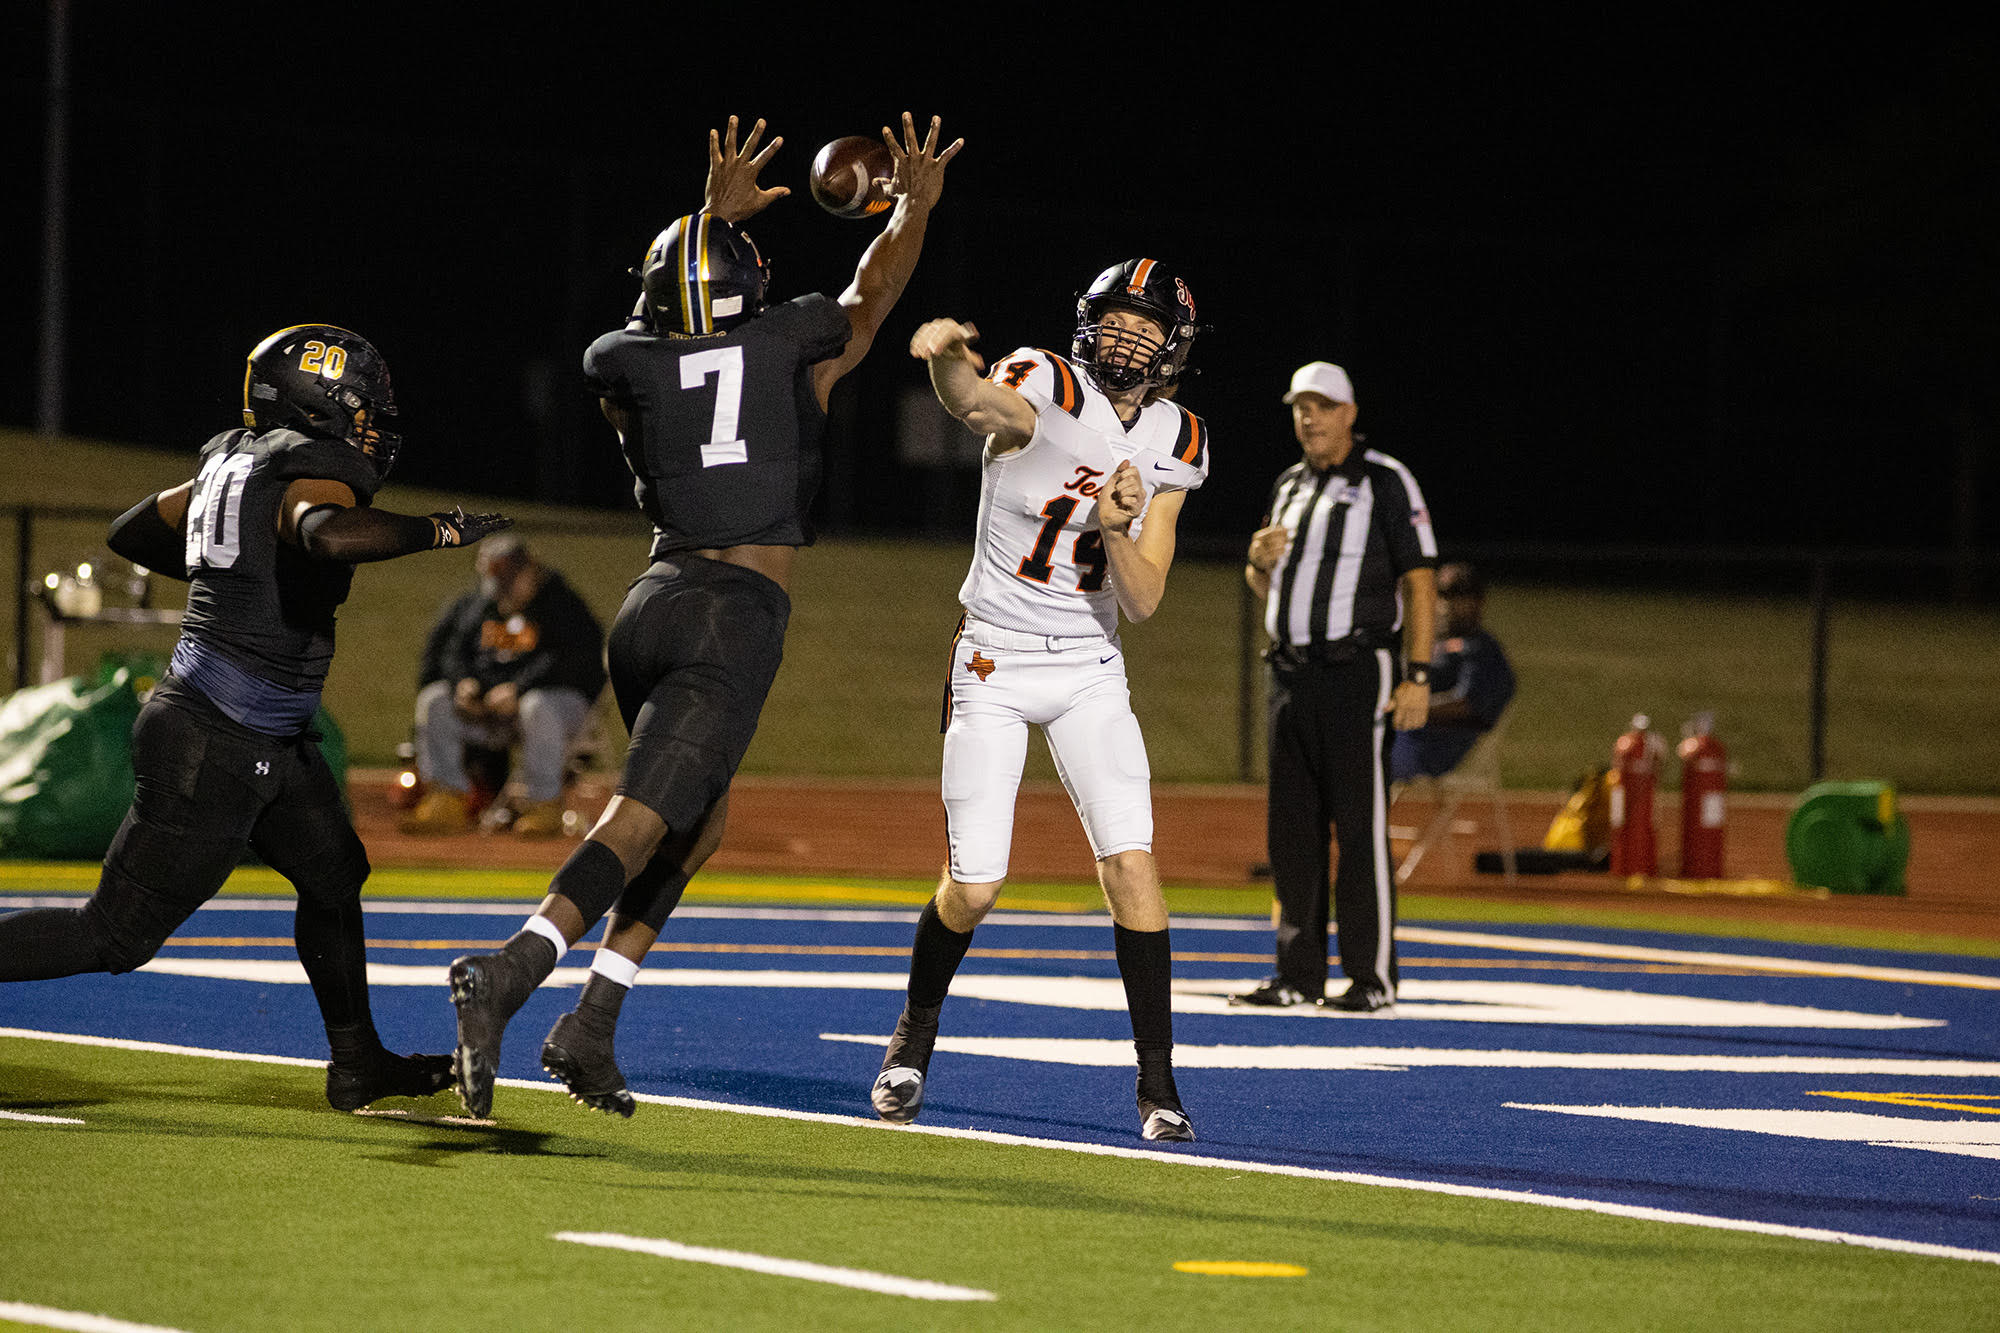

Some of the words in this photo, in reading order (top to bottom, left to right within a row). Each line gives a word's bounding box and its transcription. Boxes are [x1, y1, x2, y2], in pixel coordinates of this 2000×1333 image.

[299, 340, 348, 380] 20
[679, 345, 748, 468] 7
[185, 452, 254, 569] 20
